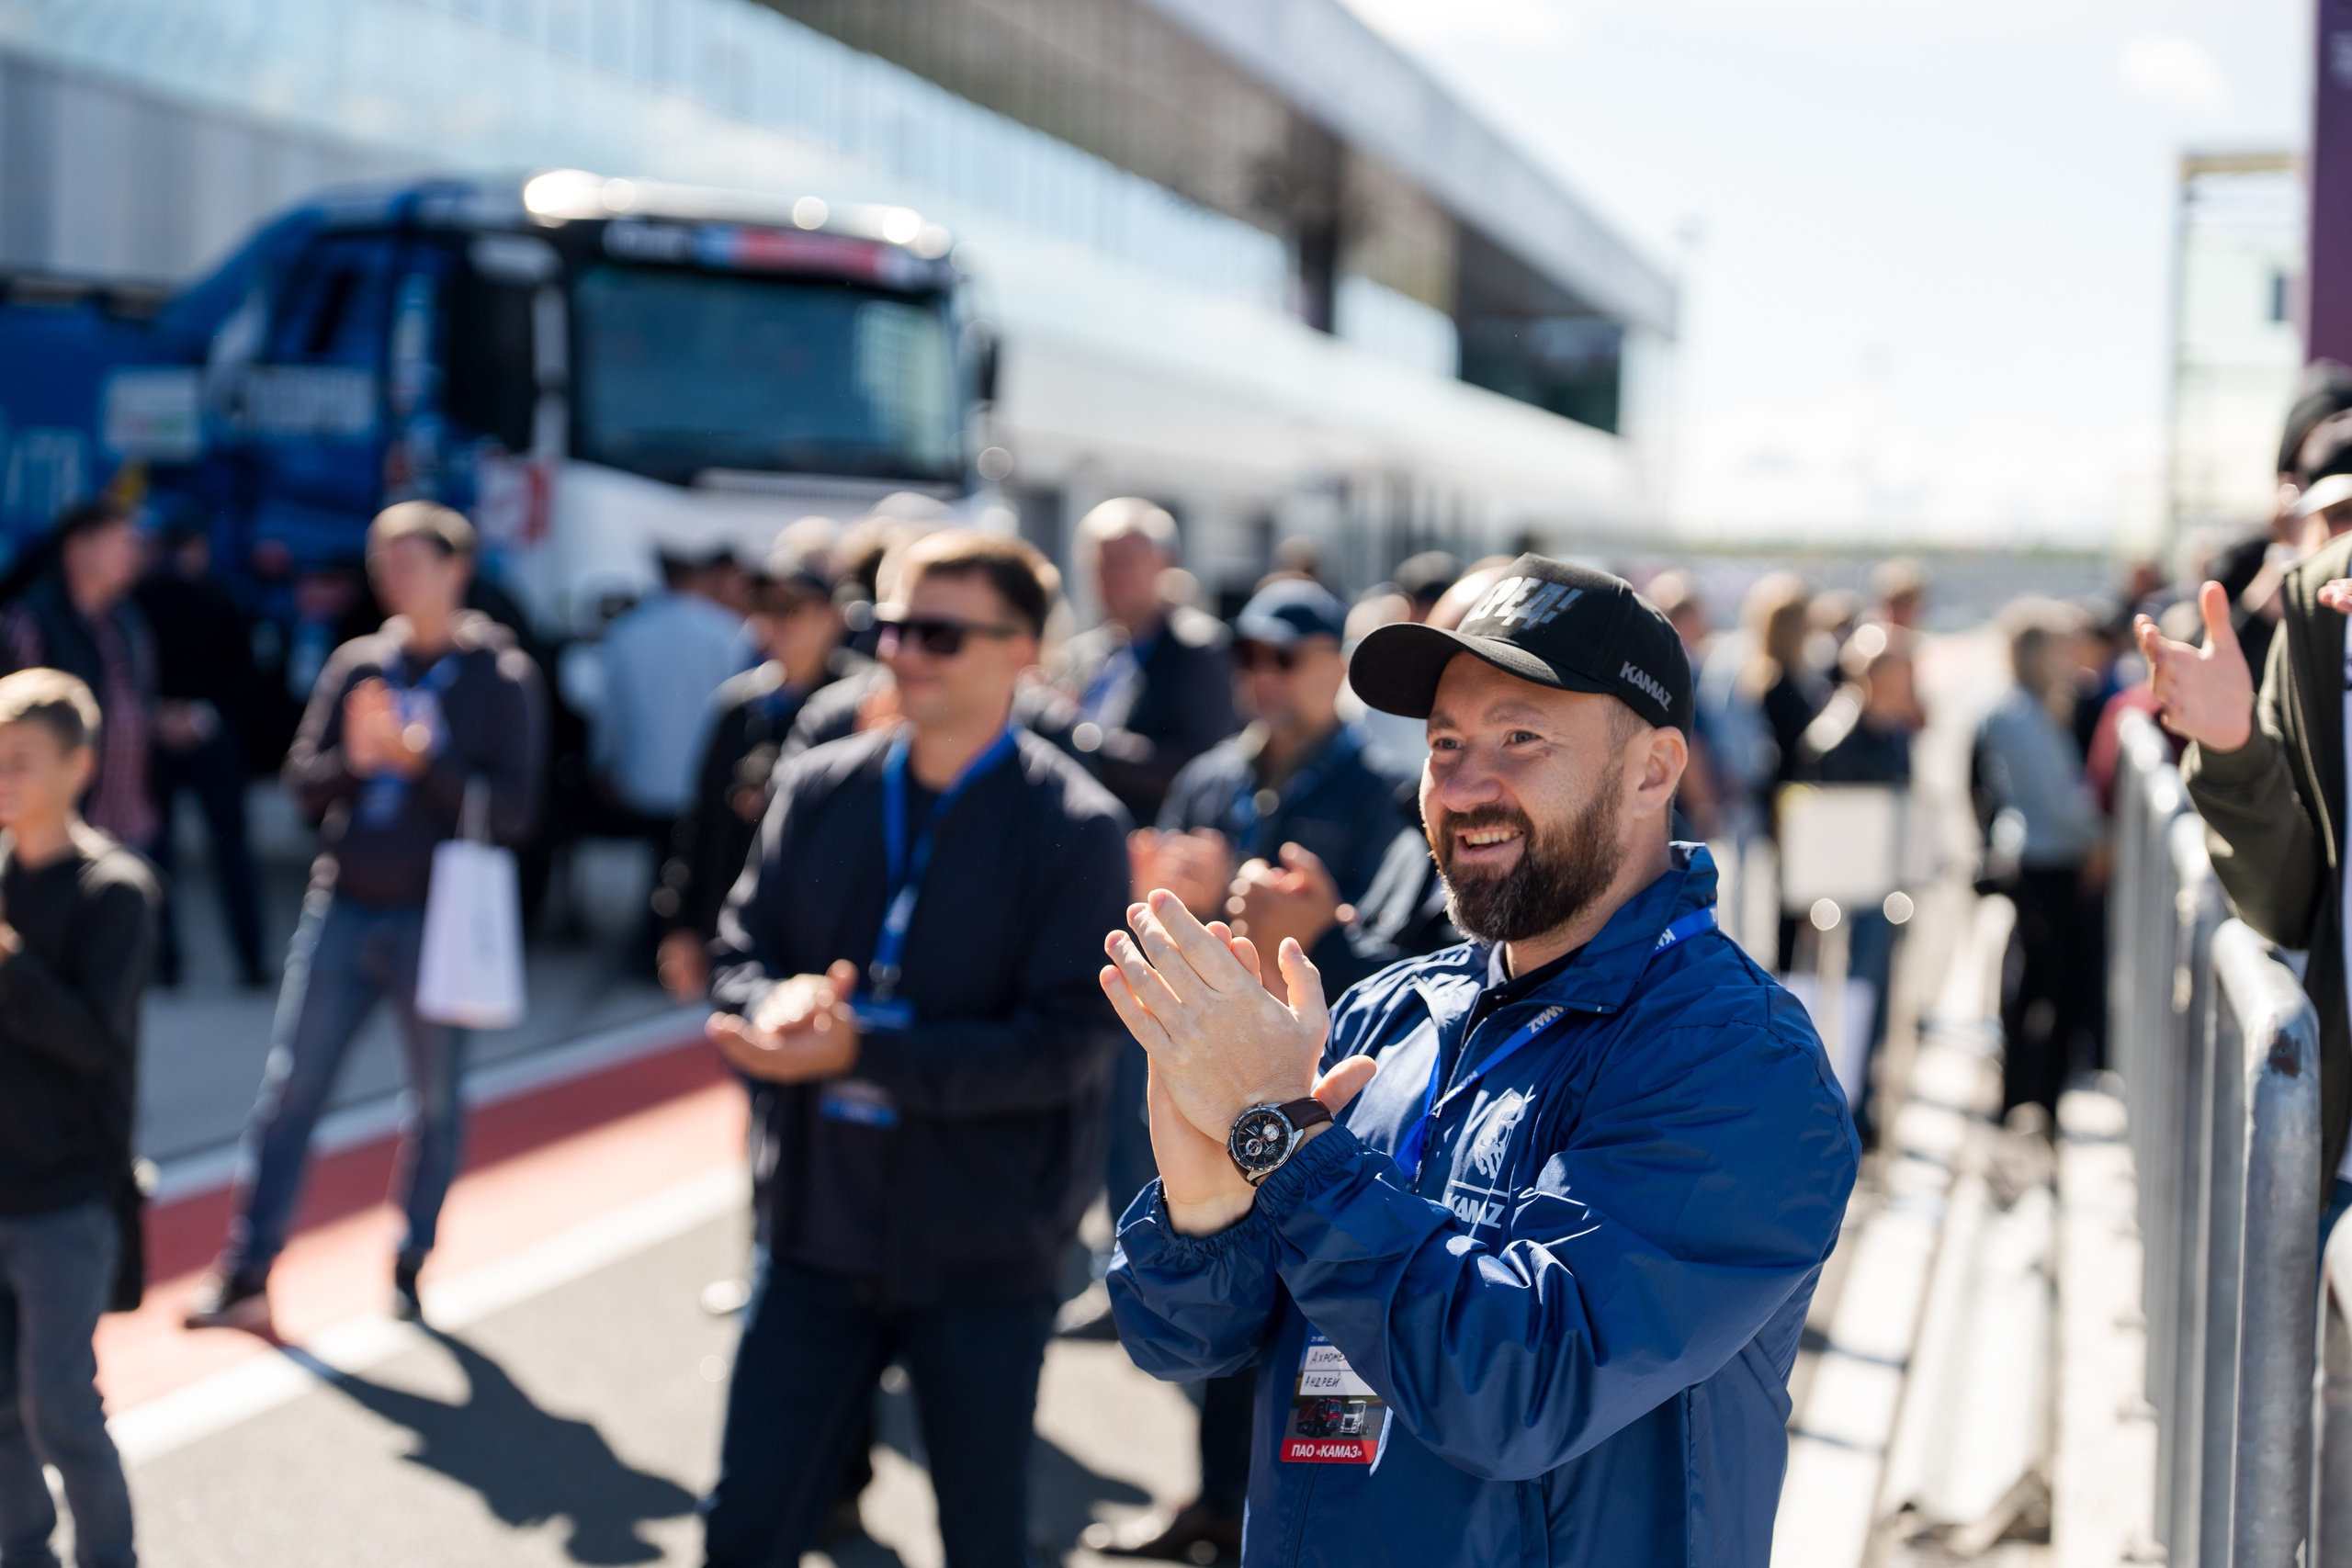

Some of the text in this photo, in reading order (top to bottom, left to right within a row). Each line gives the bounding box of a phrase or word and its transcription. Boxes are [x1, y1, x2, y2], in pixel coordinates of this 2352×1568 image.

[1620, 660, 1672, 712] KAMAZ
[1310, 1351, 1346, 1365] АХРОМЕ
[1291, 1444, 1315, 1457] ПАО
